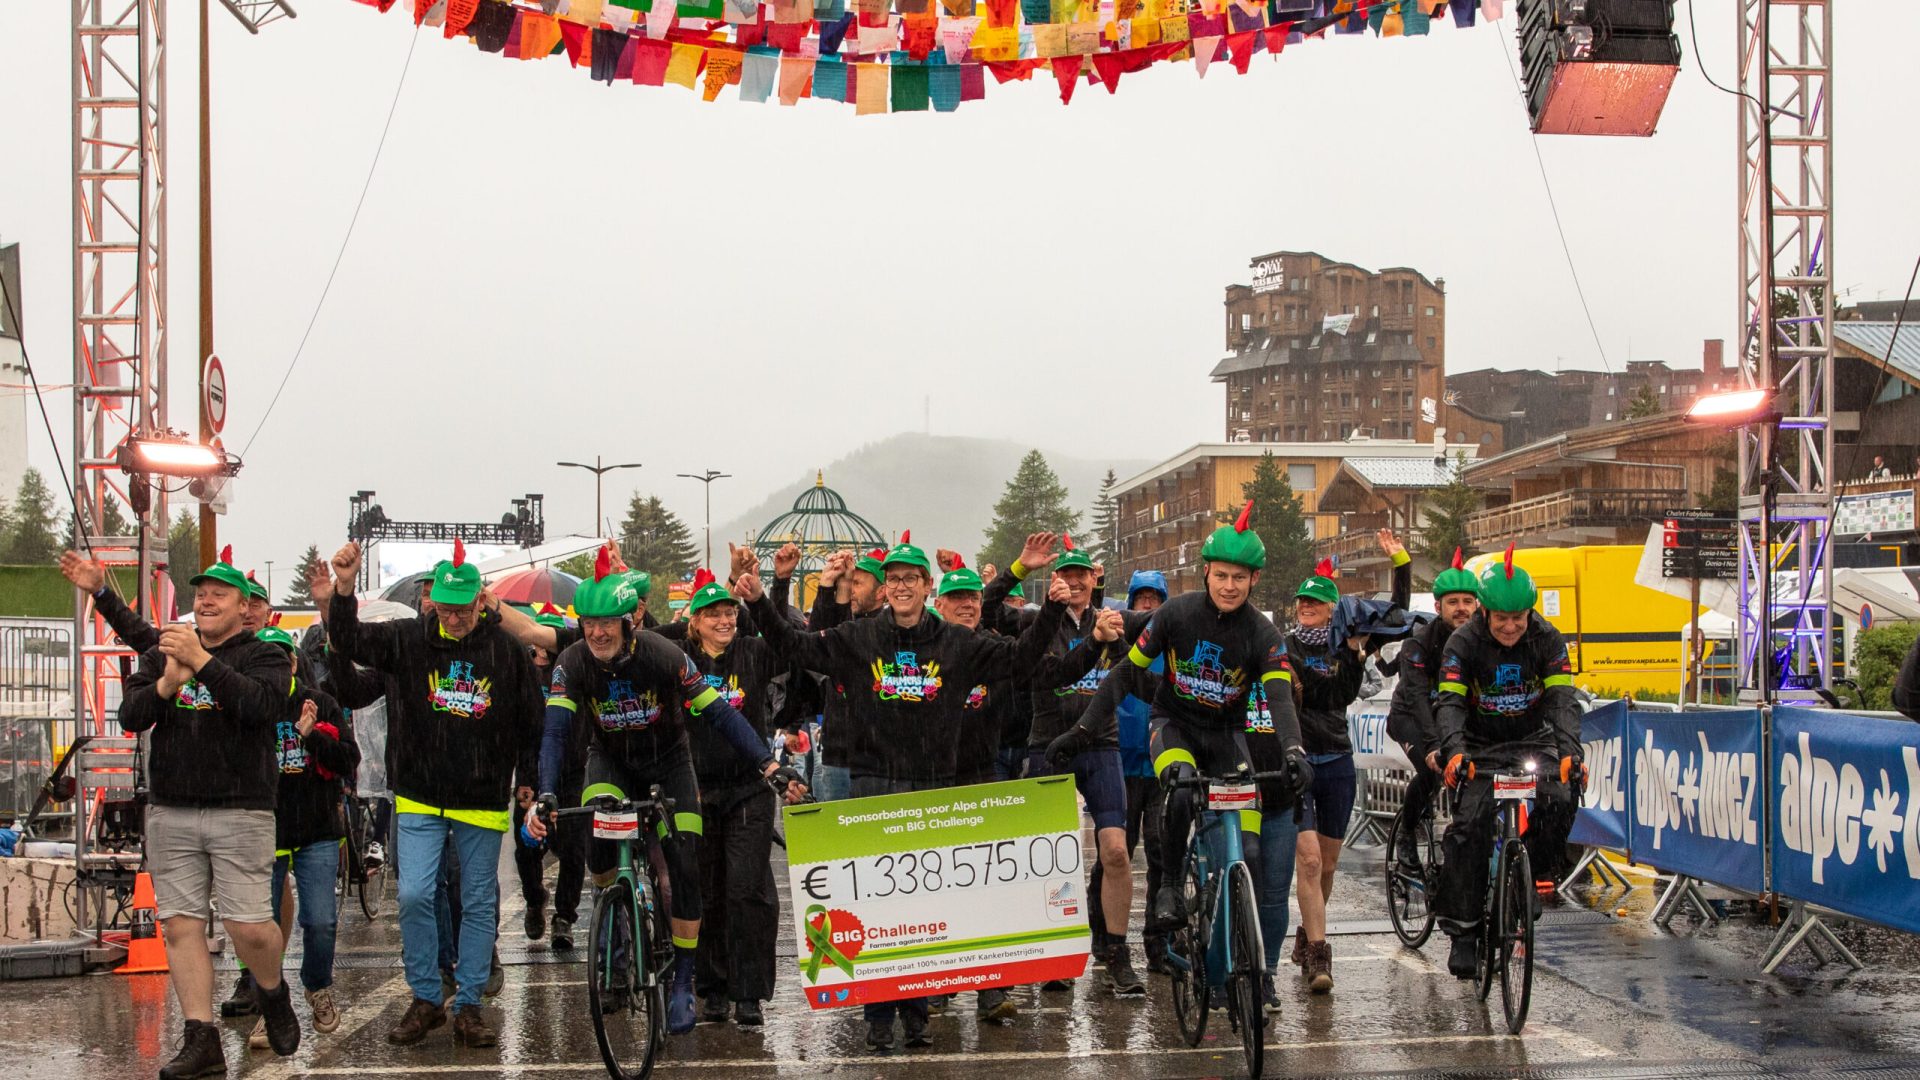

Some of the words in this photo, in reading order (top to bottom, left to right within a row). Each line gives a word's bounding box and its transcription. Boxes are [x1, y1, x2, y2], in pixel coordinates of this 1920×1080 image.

[882, 675, 922, 686] FARMERS
[1176, 671, 1223, 693] FARMERS
[436, 688, 473, 702] FARMERS
[896, 685, 925, 696] COOL
[1191, 688, 1225, 703] COOL
[1480, 693, 1526, 704] FARMERS
[446, 700, 474, 713] COOL
[599, 709, 645, 721] FARMERS
[1497, 701, 1528, 712] COOL
[1348, 714, 1387, 754] NZET!
[1635, 729, 1681, 849] alpe
[1698, 731, 1757, 845] huez
[838, 807, 922, 826] Sponsorbedrag
[925, 804, 950, 814] voor
[952, 801, 978, 812] Alpe
[980, 795, 1026, 809] d'HuZes
[1780, 731, 1865, 885] alpe
[883, 825, 904, 834] van
[906, 821, 926, 833] BIG
[928, 814, 984, 829] Challenge
[801, 865, 831, 900] €
[842, 833, 1080, 901] 1.338.575,00
[833, 929, 863, 944] BIG
[867, 921, 947, 939] Challenge
[869, 941, 897, 949] Farmers
[898, 937, 924, 946] against
[925, 934, 949, 942] cancer
[855, 965, 896, 976] Opbrengst
[897, 963, 915, 972] gaat
[917, 959, 938, 968] 100%
[958, 955, 977, 963] KWF
[978, 947, 1045, 961] Kankerbestrijding
[898, 973, 1002, 991] www.bigchallenge.eu
